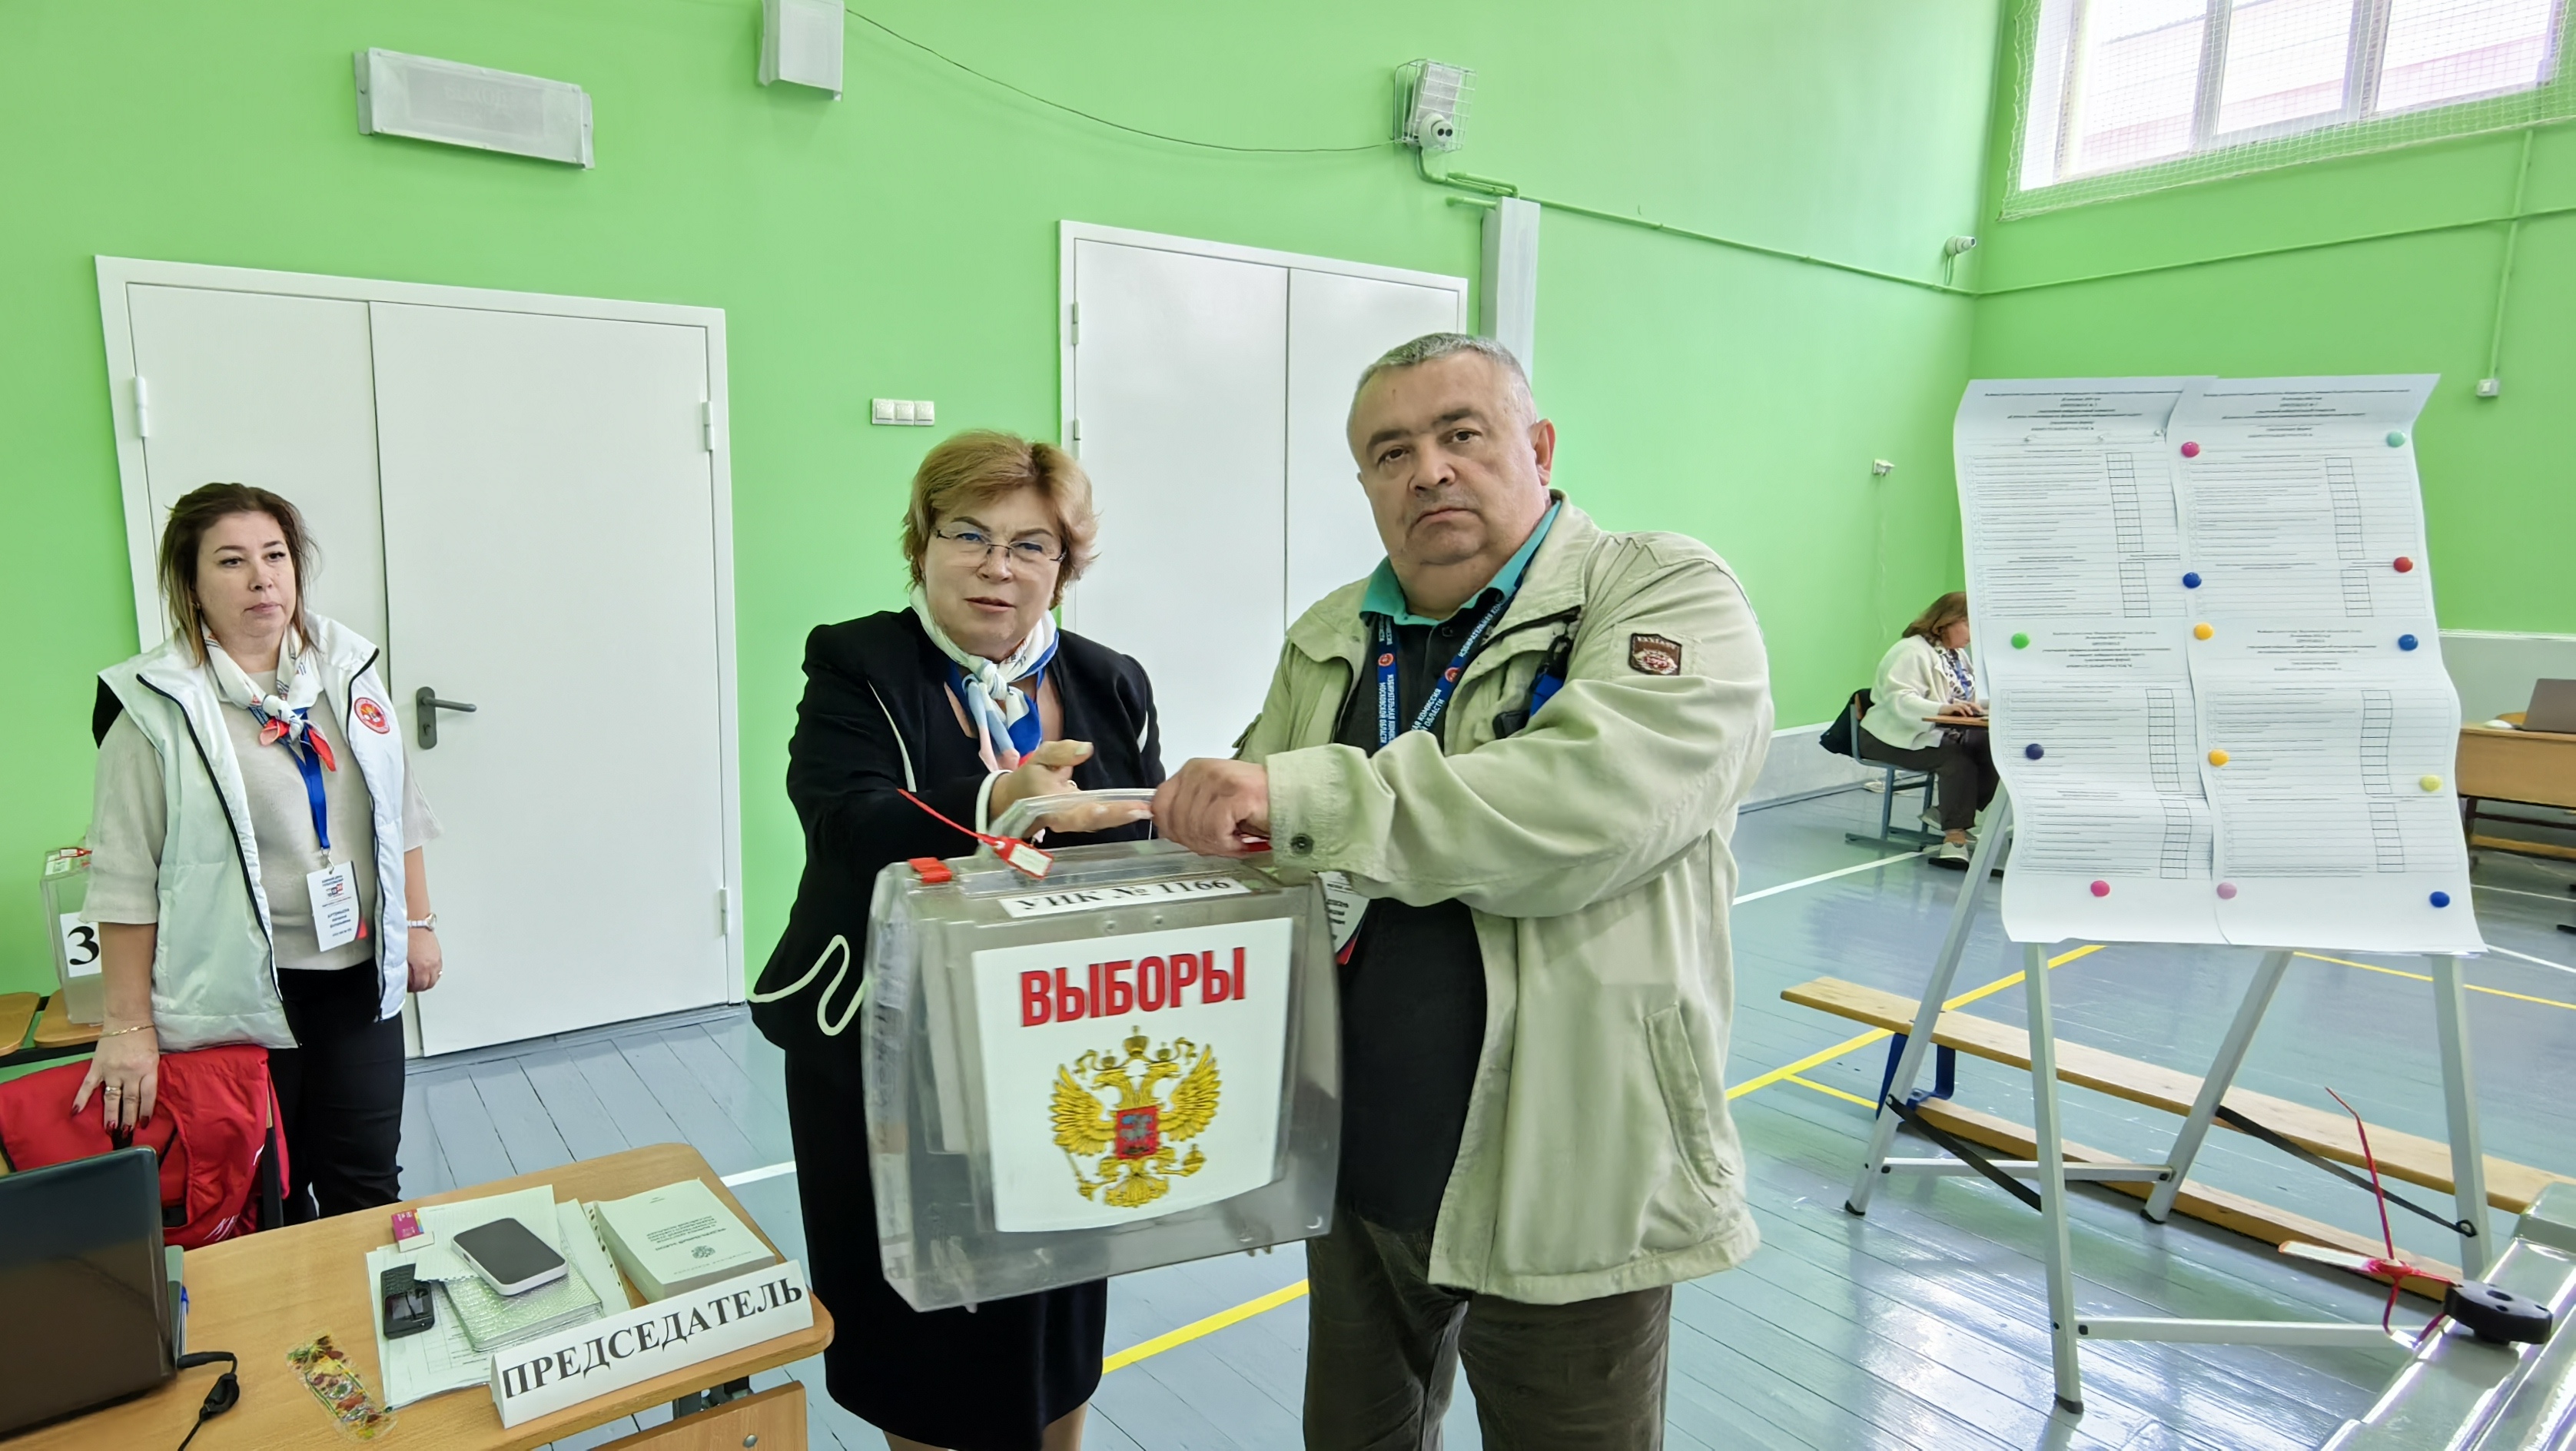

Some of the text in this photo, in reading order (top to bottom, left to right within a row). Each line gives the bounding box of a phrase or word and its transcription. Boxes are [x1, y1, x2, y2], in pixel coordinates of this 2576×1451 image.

[1417, 688, 1442, 722] КОМИССИЯ
[1423, 698, 1445, 727] ОБЛАСТИ
[1016, 879, 1232, 911] УИК № 1166
[66, 925, 100, 966] 3
[1021, 946, 1246, 1028] ВЫБОРЫ
[502, 1277, 802, 1399] ПРЕДСЕДАТЕЛЬ
